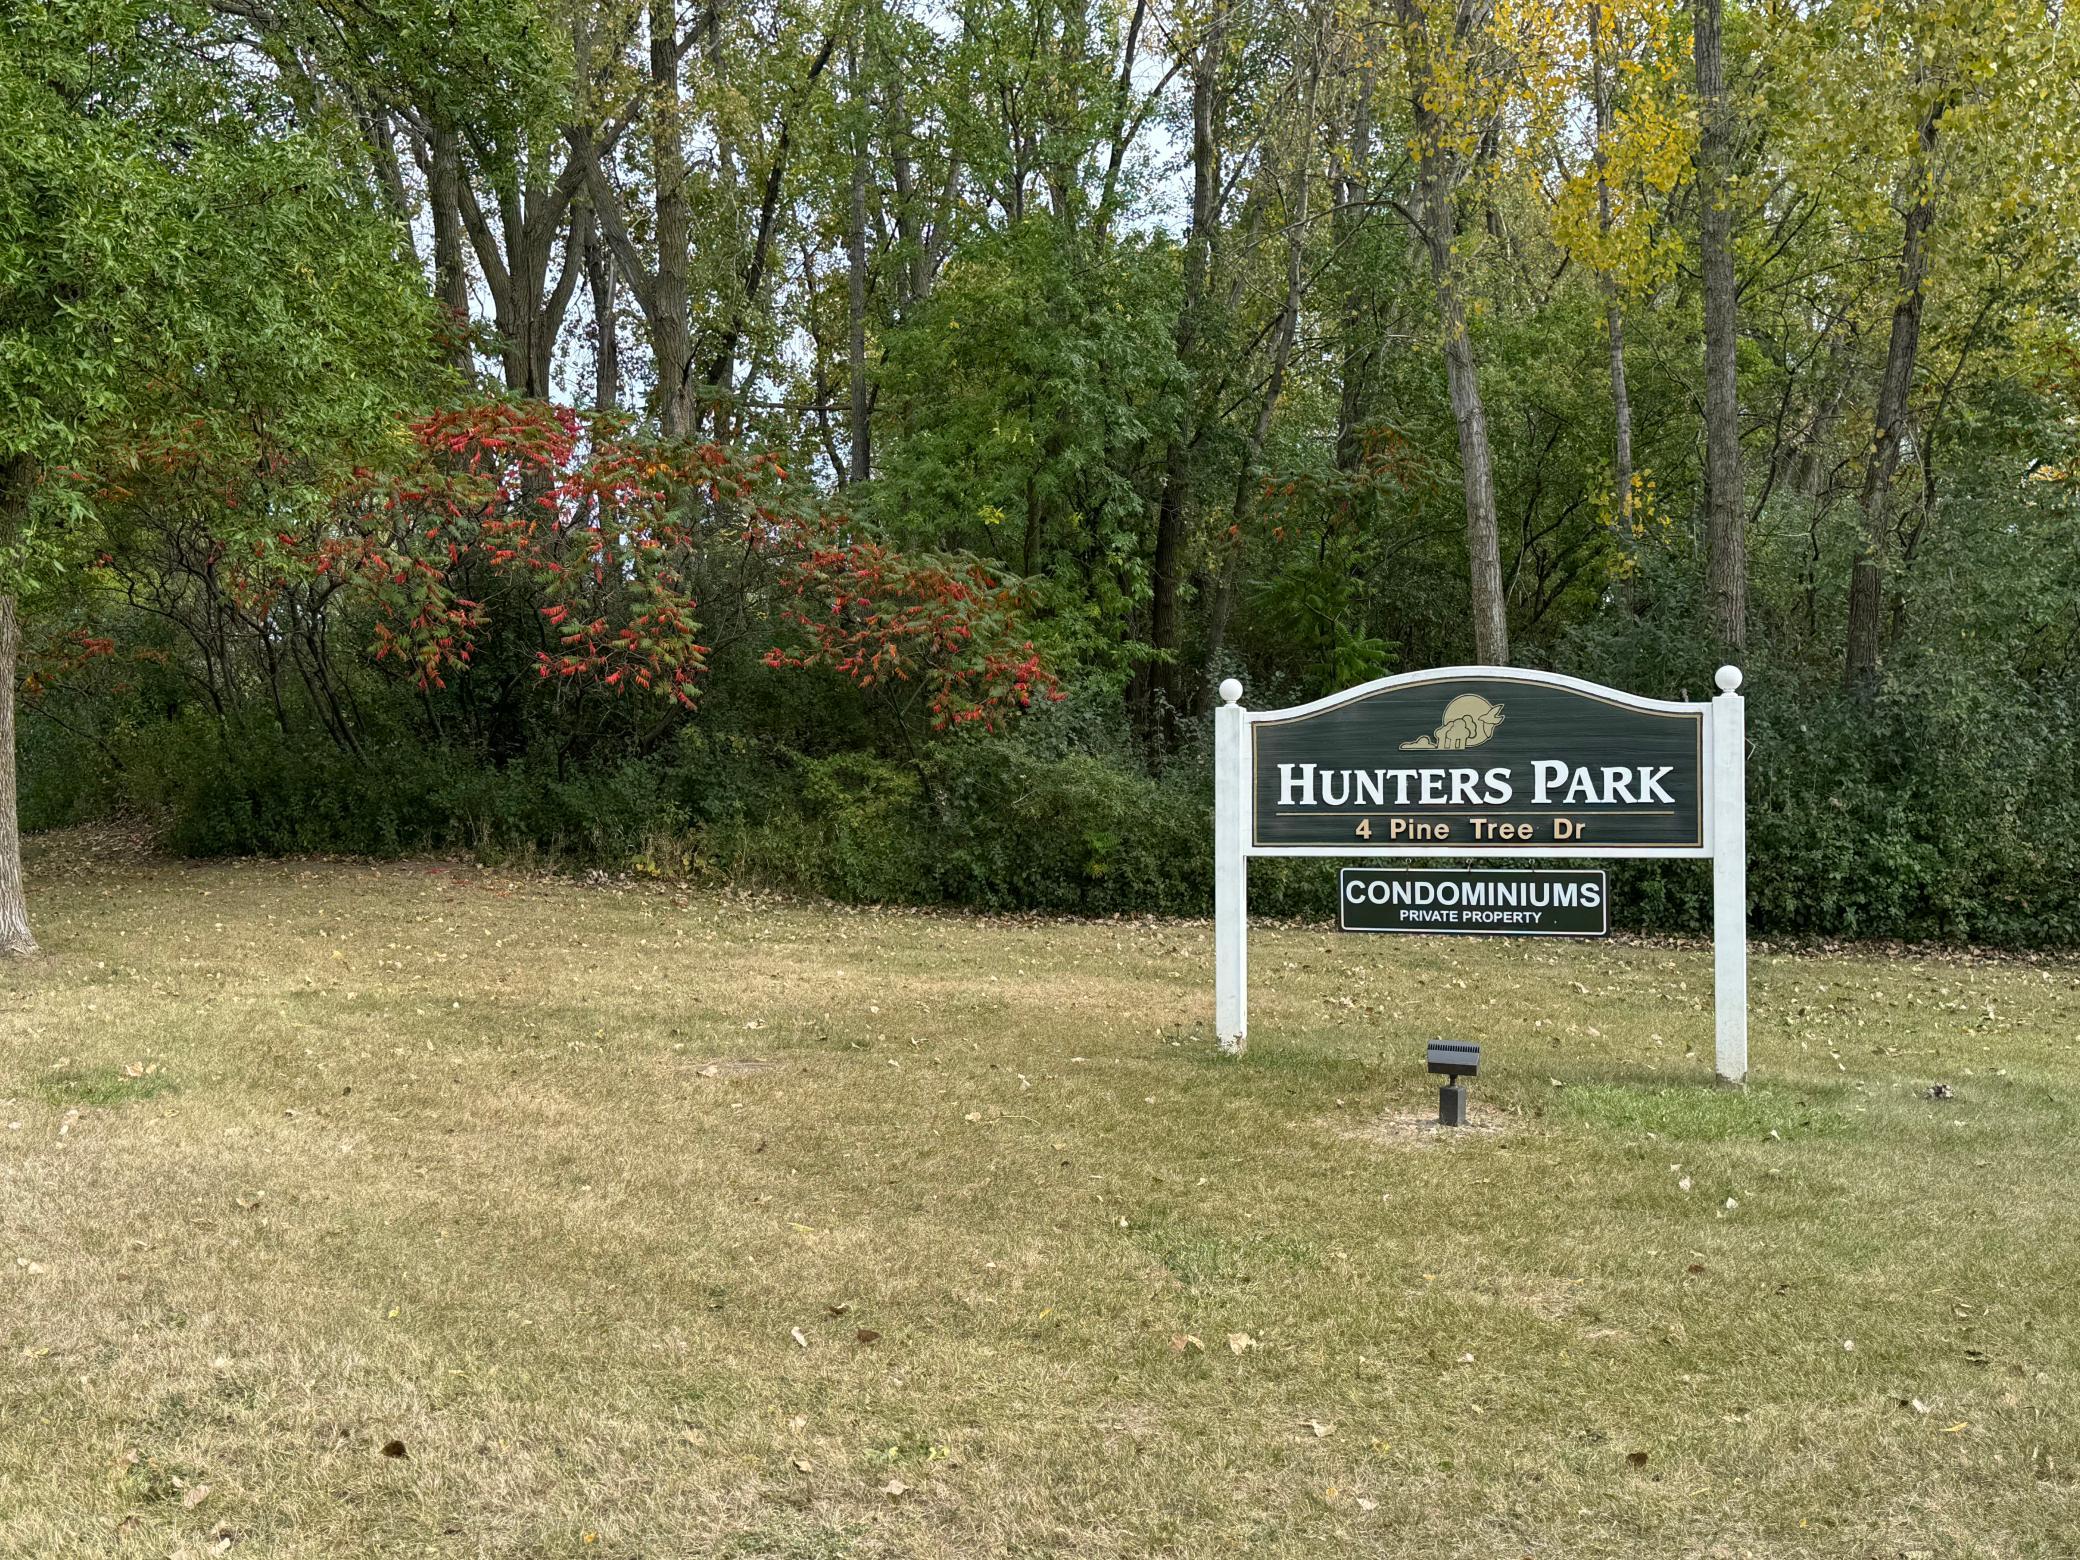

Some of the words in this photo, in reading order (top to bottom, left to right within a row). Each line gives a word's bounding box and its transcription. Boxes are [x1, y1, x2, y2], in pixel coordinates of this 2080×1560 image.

[1277, 764, 1512, 805] HUNTERS
[1531, 760, 1675, 803] PARK
[1355, 818, 1373, 840] 4
[1390, 819, 1450, 840] Pine
[1469, 818, 1534, 840] Tree
[1553, 818, 1586, 840] Dr
[1346, 880, 1600, 907] CONDOMINIUMS
[1399, 909, 1459, 922] PRIVATE
[1462, 910, 1542, 924] PROPERTY
